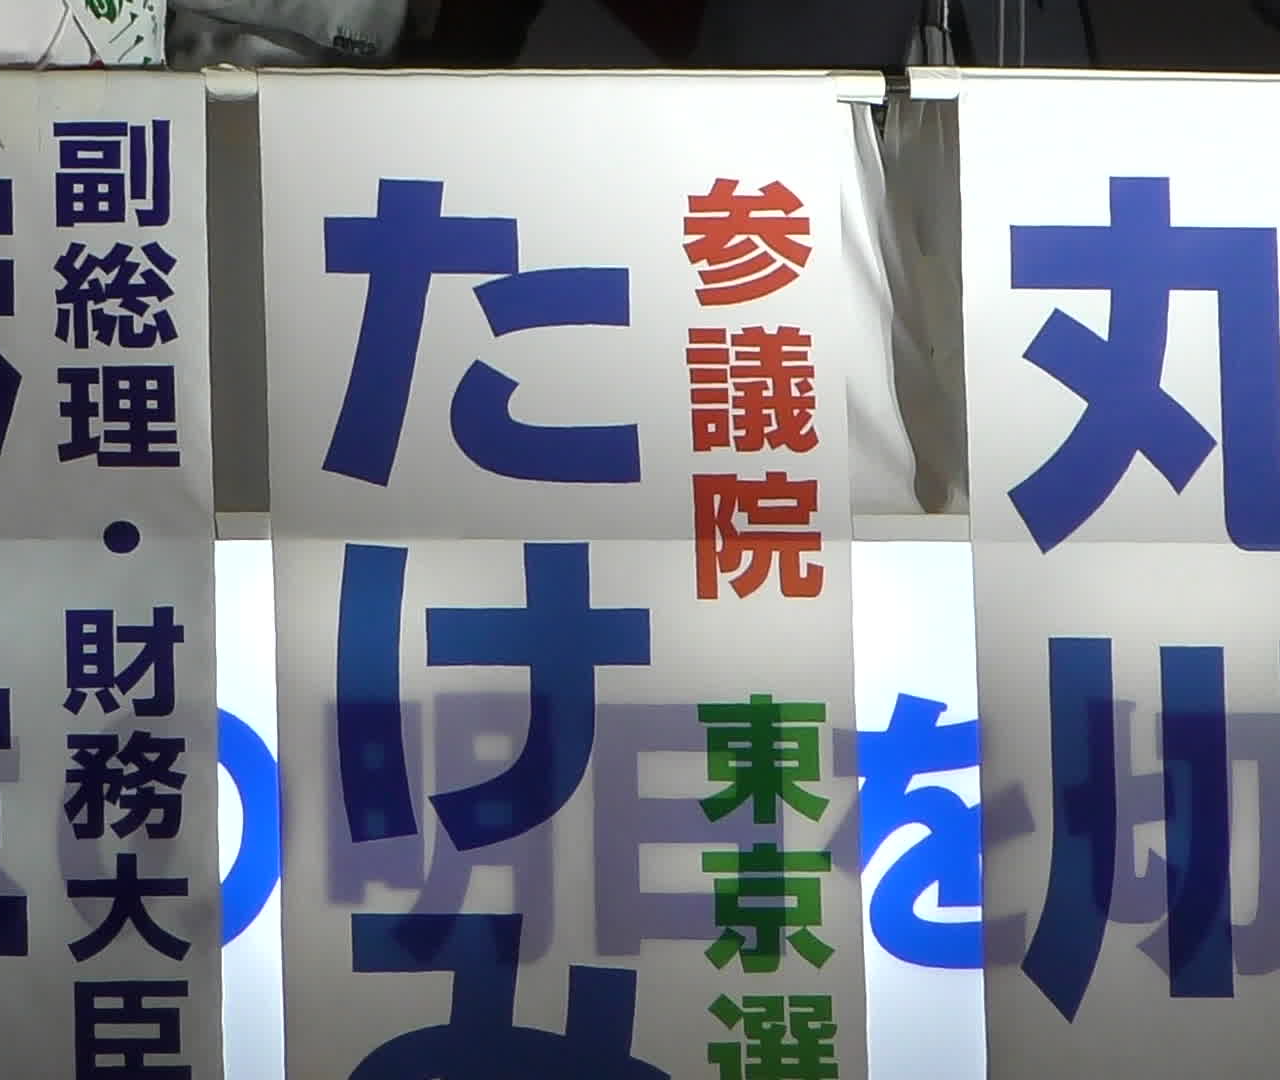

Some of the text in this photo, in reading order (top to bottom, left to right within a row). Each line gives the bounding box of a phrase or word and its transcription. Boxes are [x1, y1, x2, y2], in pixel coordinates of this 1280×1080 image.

[683, 178, 839, 1080] 参議院 東京選
